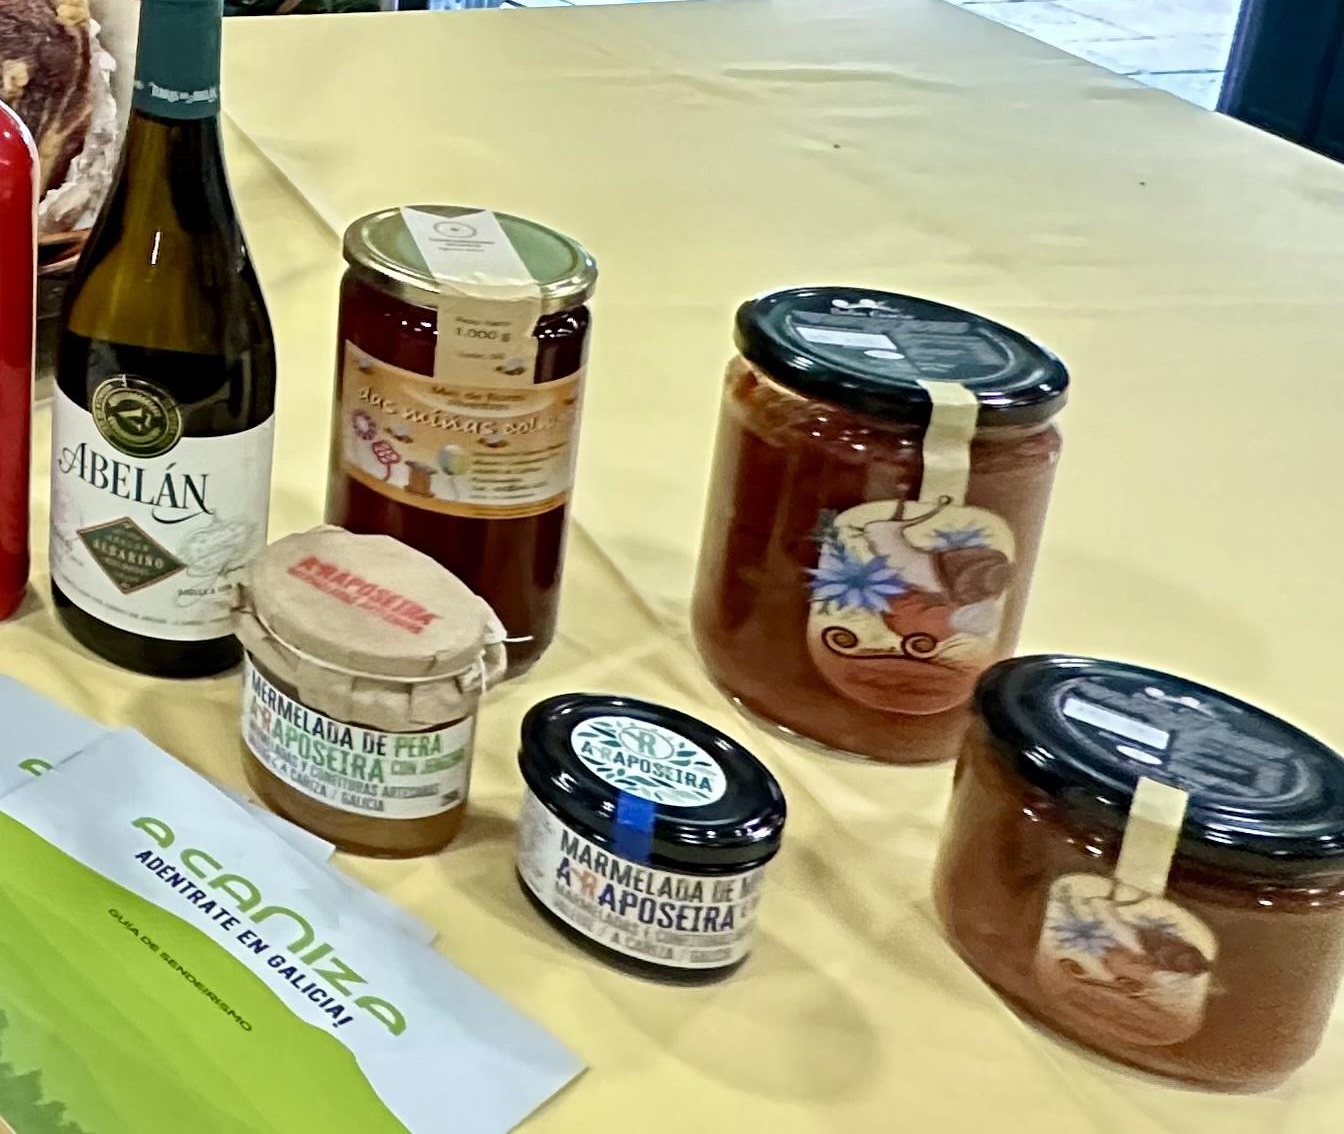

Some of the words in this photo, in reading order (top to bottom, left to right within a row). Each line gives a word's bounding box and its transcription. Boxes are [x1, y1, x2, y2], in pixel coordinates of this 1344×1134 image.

[58, 442, 216, 524] ABELÁN
[250, 669, 355, 751] MERMELADA
[362, 731, 389, 756] DE
[393, 733, 443, 759] PERA
[560, 828, 704, 903] MARMELADA
[135, 849, 238, 932] ADÉNTRATE
[237, 930, 270, 956] EN
[266, 952, 354, 1029] GALICIA!
[139, 934, 161, 952] DE
[159, 950, 254, 1032] SENDEIRISMO
